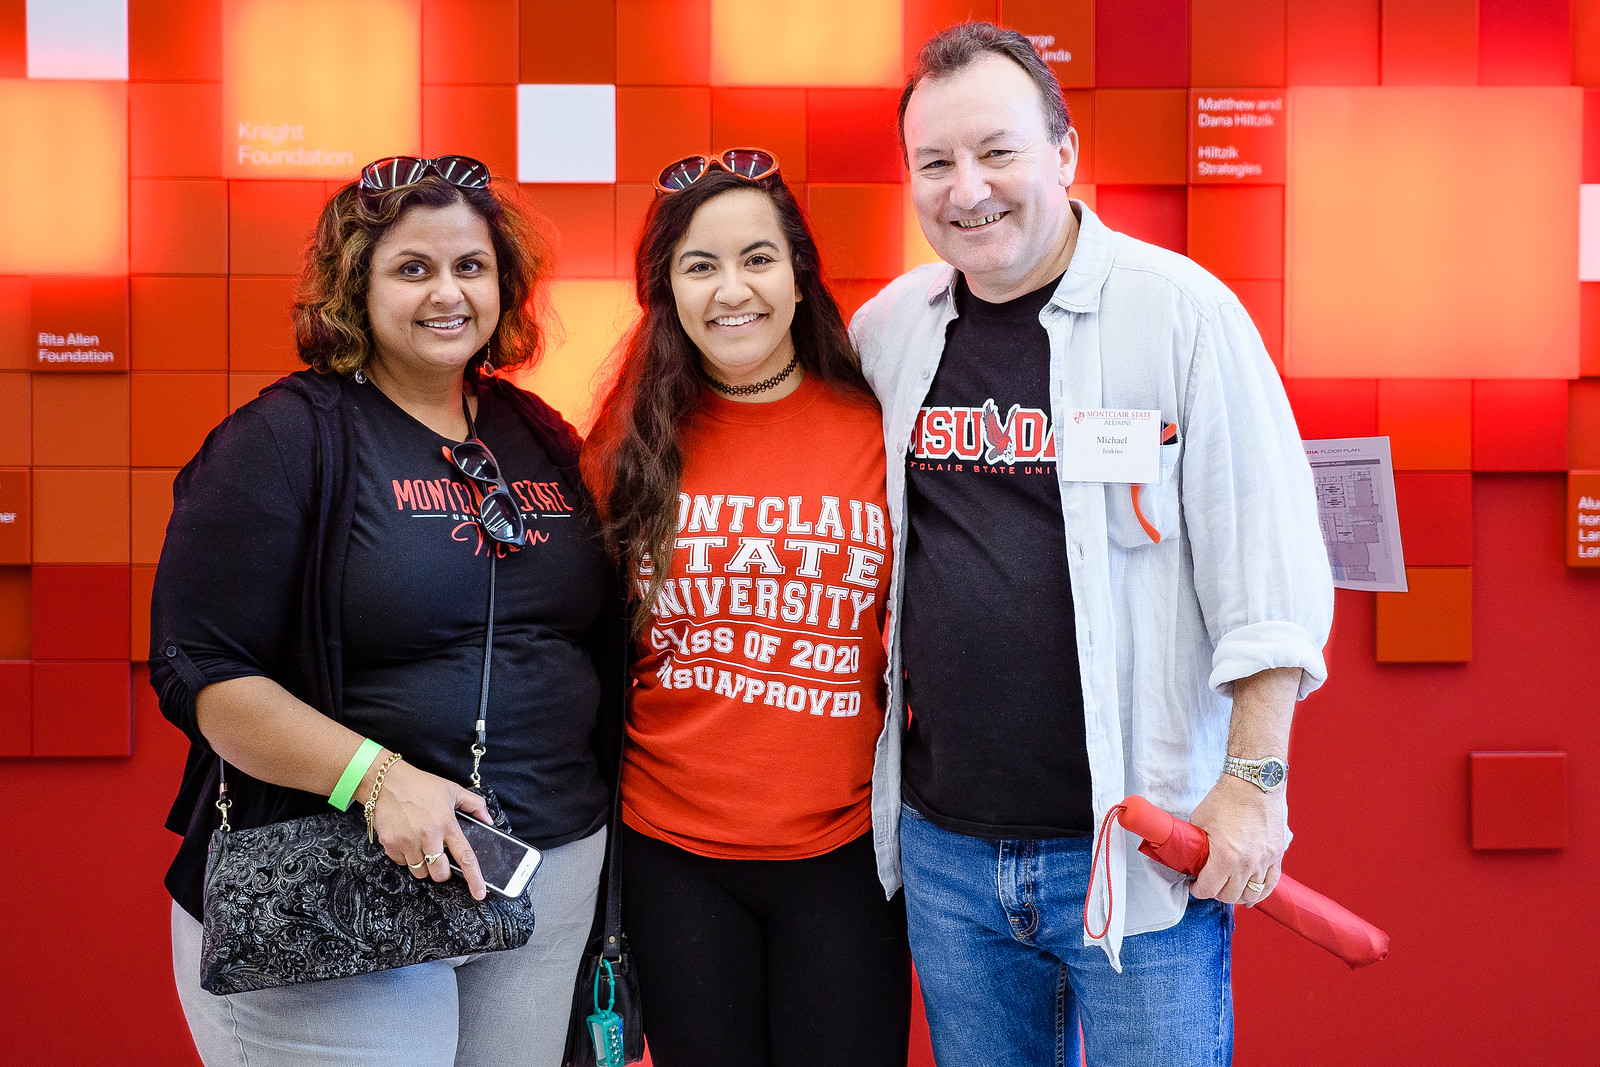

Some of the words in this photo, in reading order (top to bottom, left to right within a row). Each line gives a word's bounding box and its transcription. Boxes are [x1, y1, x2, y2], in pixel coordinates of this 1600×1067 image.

[1198, 97, 1256, 111] Matthew
[1257, 98, 1282, 111] and
[1198, 113, 1233, 127] Dana
[1234, 113, 1275, 127] Hiltzik
[238, 121, 304, 145] Knight
[238, 145, 354, 166] Foundation
[1198, 146, 1239, 159] Hiltzik
[1198, 161, 1262, 178] Strategies
[38, 332, 65, 346] Rita
[67, 332, 99, 346] Allen
[38, 348, 115, 362] Foundation
[1131, 411, 1151, 419] STATE
[1096, 436, 1128, 444] Michael
[910, 460, 963, 472] TCLAIR
[973, 465, 1015, 475] STATE
[511, 480, 574, 512] STATE
[671, 491, 887, 551] ONTCLAIR
[637, 535, 885, 590] TATE
[743, 629, 782, 664] OF
[789, 638, 860, 674] 2020
